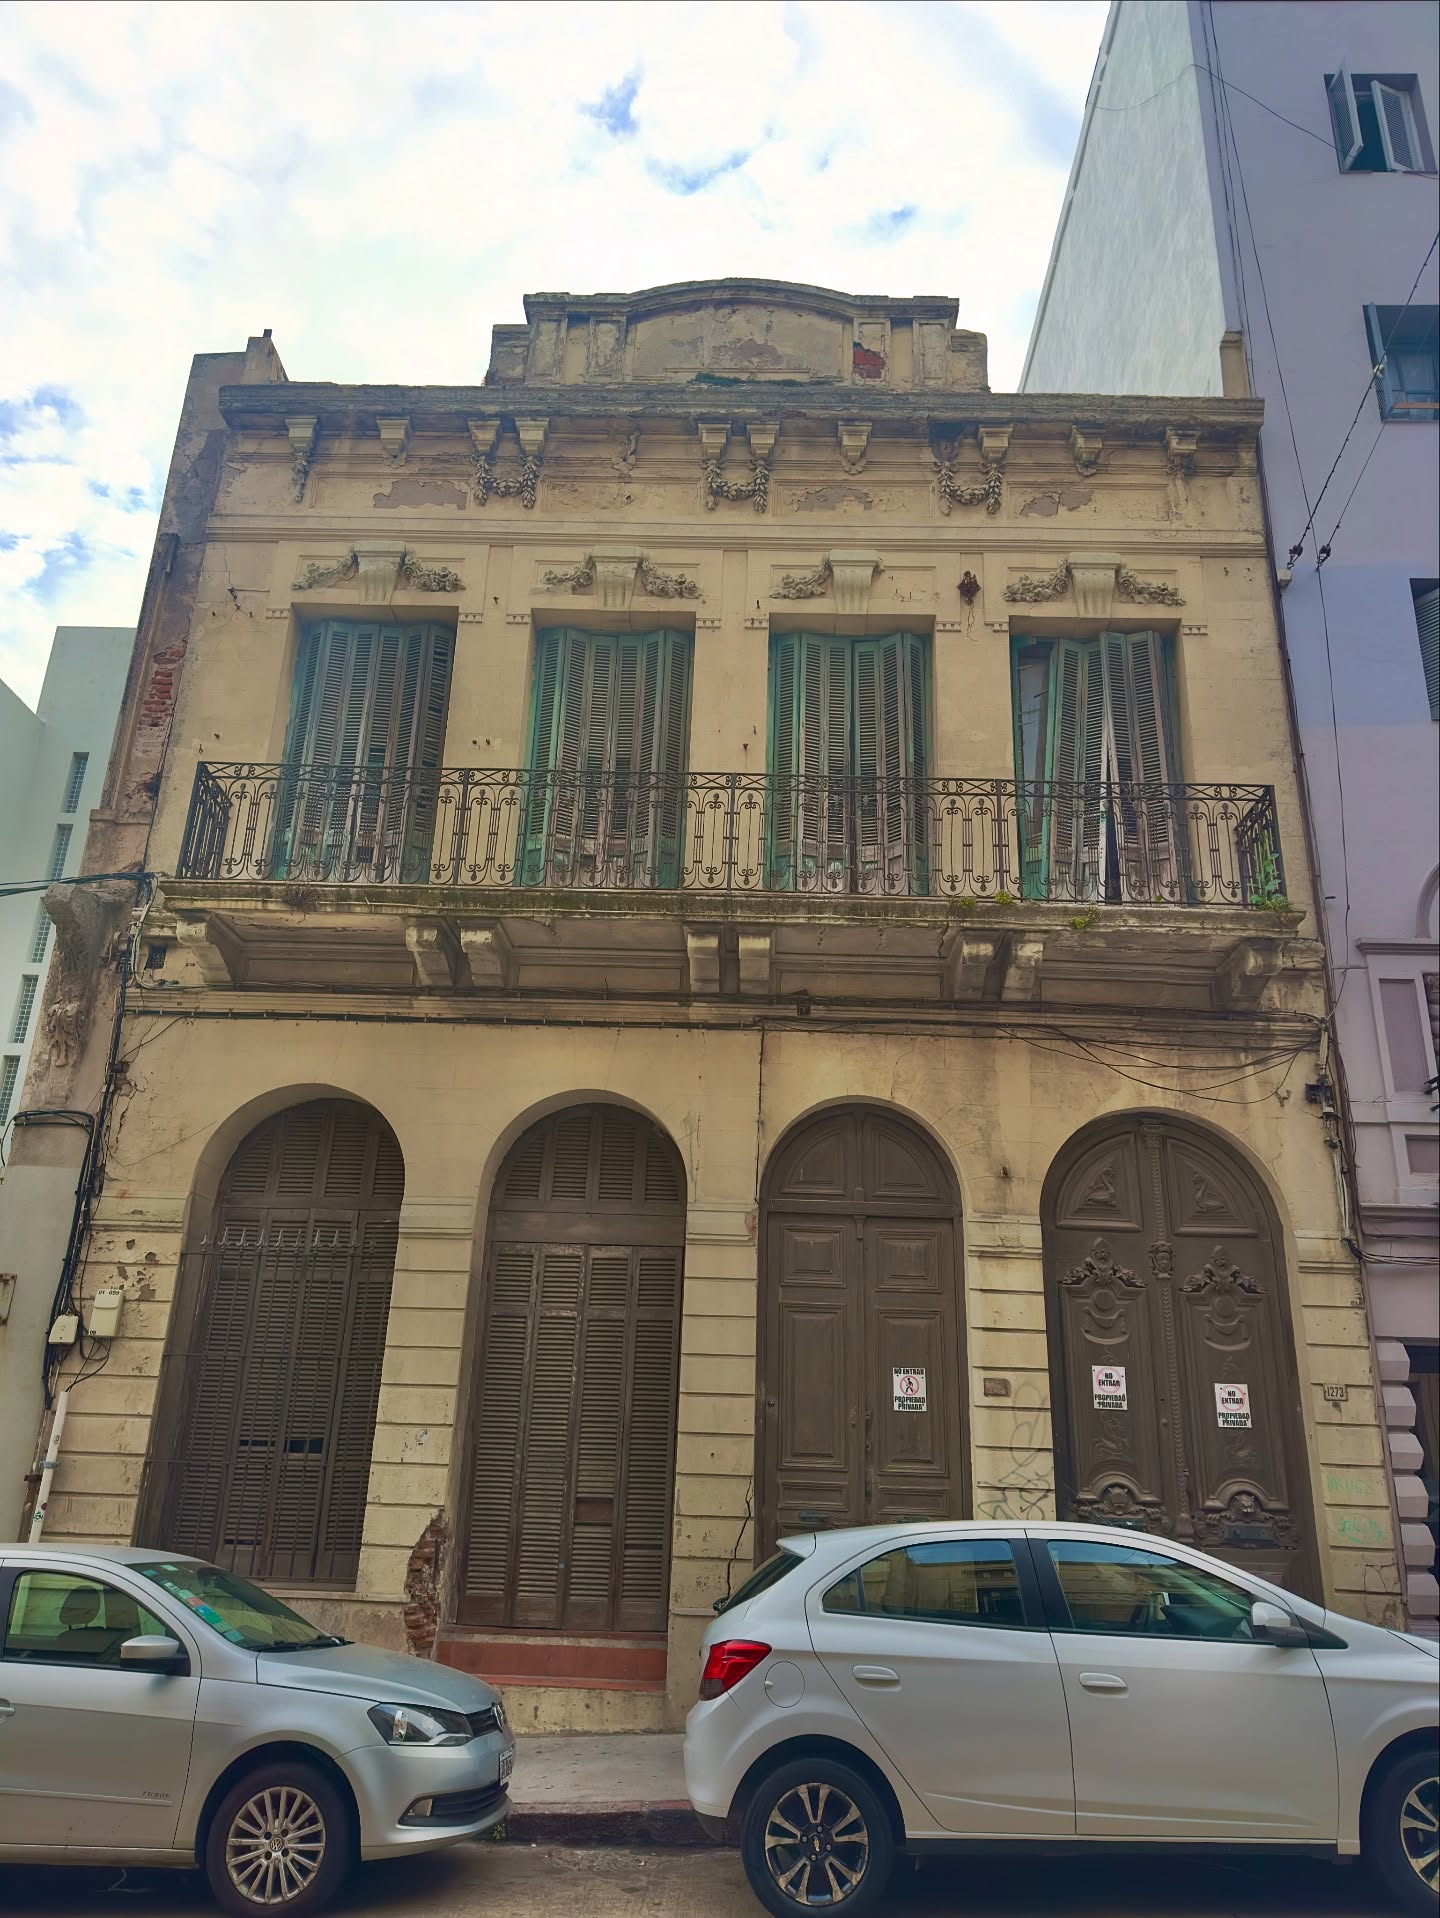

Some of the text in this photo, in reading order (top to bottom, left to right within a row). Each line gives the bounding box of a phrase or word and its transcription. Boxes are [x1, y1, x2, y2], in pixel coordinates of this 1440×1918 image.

[903, 1368, 925, 1376] ENTRAR
[1098, 1379, 1121, 1387] ENTRAR
[1227, 1390, 1236, 1398] NO
[1327, 1386, 1345, 1398] 1273
[895, 1396, 926, 1404] PROPIEDAD
[1095, 1394, 1126, 1402] PROPIEDAD
[1221, 1397, 1244, 1405] ENTRAR
[1218, 1412, 1250, 1420] PROPIEDAD
[1222, 1419, 1248, 1427] PRIVADA
